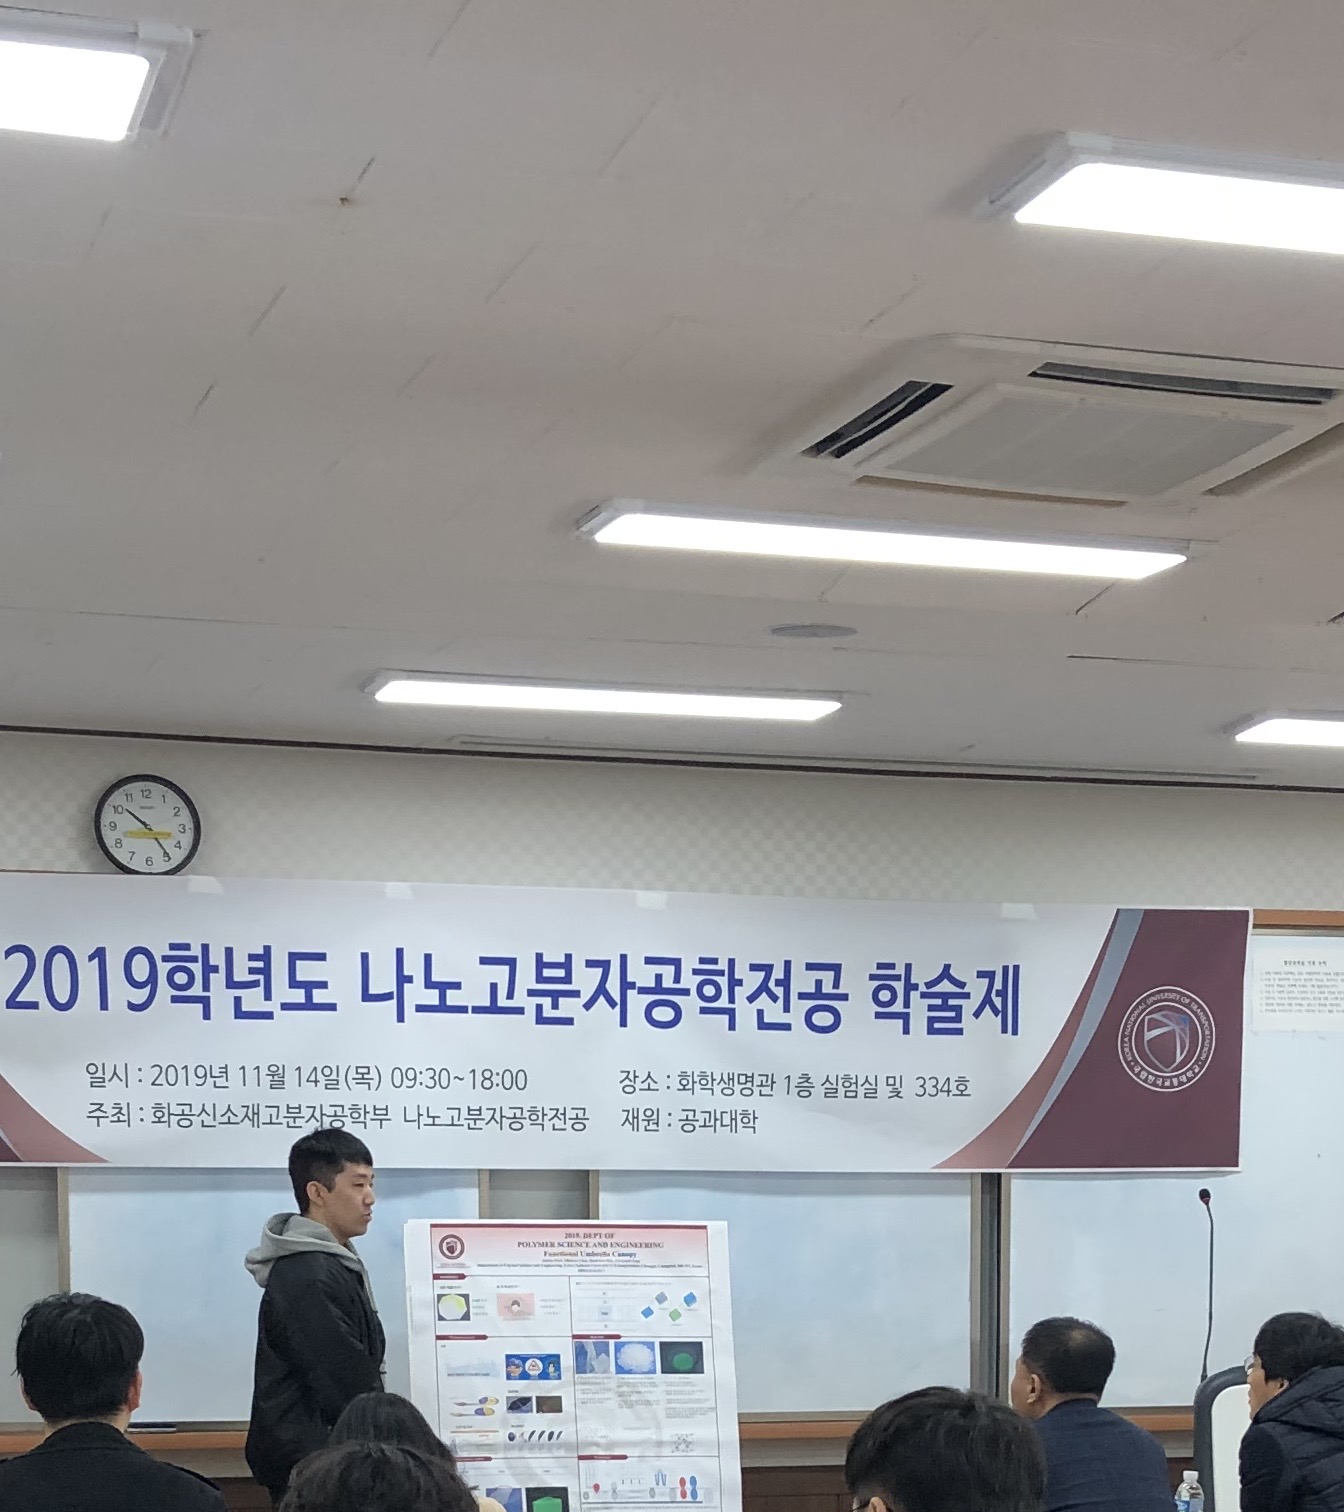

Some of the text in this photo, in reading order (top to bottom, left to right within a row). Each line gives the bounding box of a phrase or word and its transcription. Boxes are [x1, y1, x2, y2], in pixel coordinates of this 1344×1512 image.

[124, 793, 134, 803] 11
[140, 789, 152, 799] 12
[112, 804, 124, 815] 10
[173, 806, 181, 817] 2
[108, 821, 118, 831] 9
[178, 823, 187, 834] 3
[114, 838, 123, 848] 8
[174, 840, 182, 850] 4
[128, 851, 136, 861] 7
[145, 856, 154, 866] 6
[3, 942, 1020, 1036] 2019학년도 나노고분자공학전공 학술제
[86, 1062, 129, 1088] 일시
[150, 1063, 230, 1089] 2019년
[238, 1064, 286, 1090] 11월
[294, 1065, 383, 1091] 14일(목)
[390, 1066, 529, 1091] 09:30~18:00
[619, 1069, 660, 1095] 장소
[676, 1070, 777, 1097] 화학생명관
[783, 1073, 816, 1099] 1층
[820, 1073, 879, 1099] 실험실
[885, 1074, 904, 1099] 및
[914, 1075, 972, 1098] 334호
[86, 1102, 131, 1128] 주최
[151, 1102, 392, 1130] 화공신소재고분자공학부
[403, 1104, 590, 1132] 나노고분자공학전공
[621, 1107, 660, 1132] 재원
[678, 1108, 758, 1134] 공과대학
[610, 1241, 664, 1249] ENGINEERING
